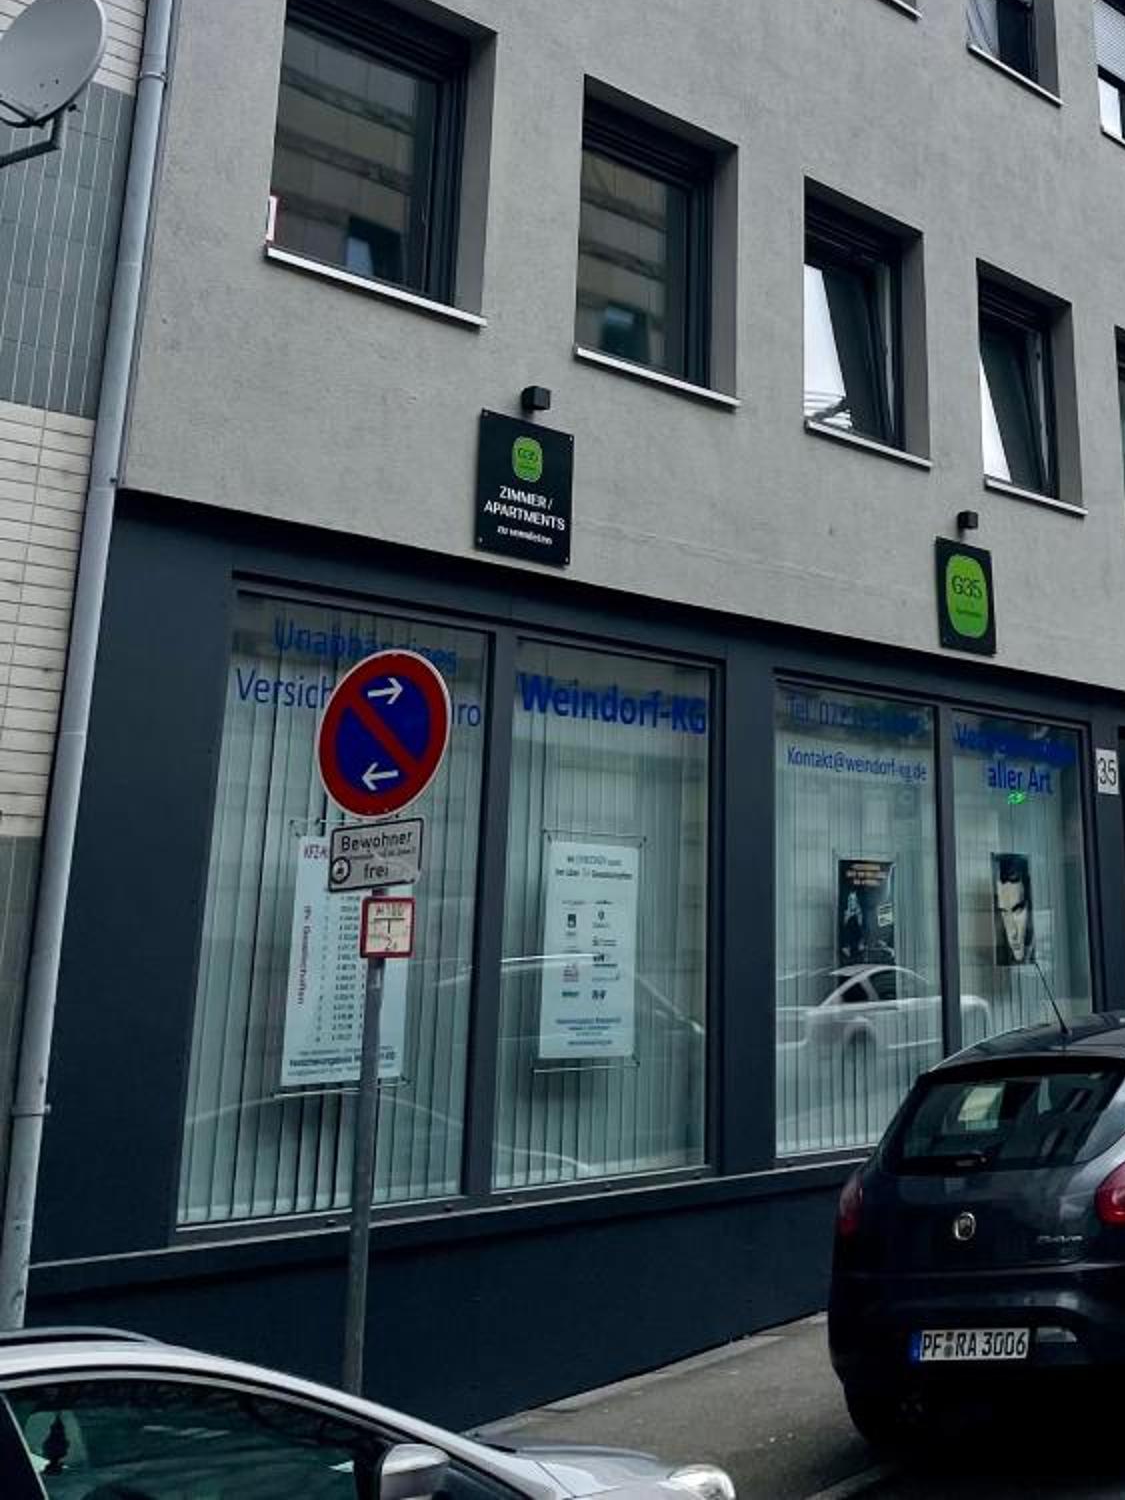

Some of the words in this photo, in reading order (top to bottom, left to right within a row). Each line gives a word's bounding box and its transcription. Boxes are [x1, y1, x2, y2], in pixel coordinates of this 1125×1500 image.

[484, 499, 566, 531] APARTMENTS
[516, 672, 707, 735] Weindorf-KG
[987, 760, 1023, 790] aller
[1028, 766, 1053, 795] Art
[1097, 757, 1118, 787] 35
[341, 831, 413, 852] Bewohner
[364, 863, 389, 880] frei
[922, 1333, 944, 1358] PF
[955, 1332, 977, 1357] RA
[982, 1331, 1027, 1356] 3006
